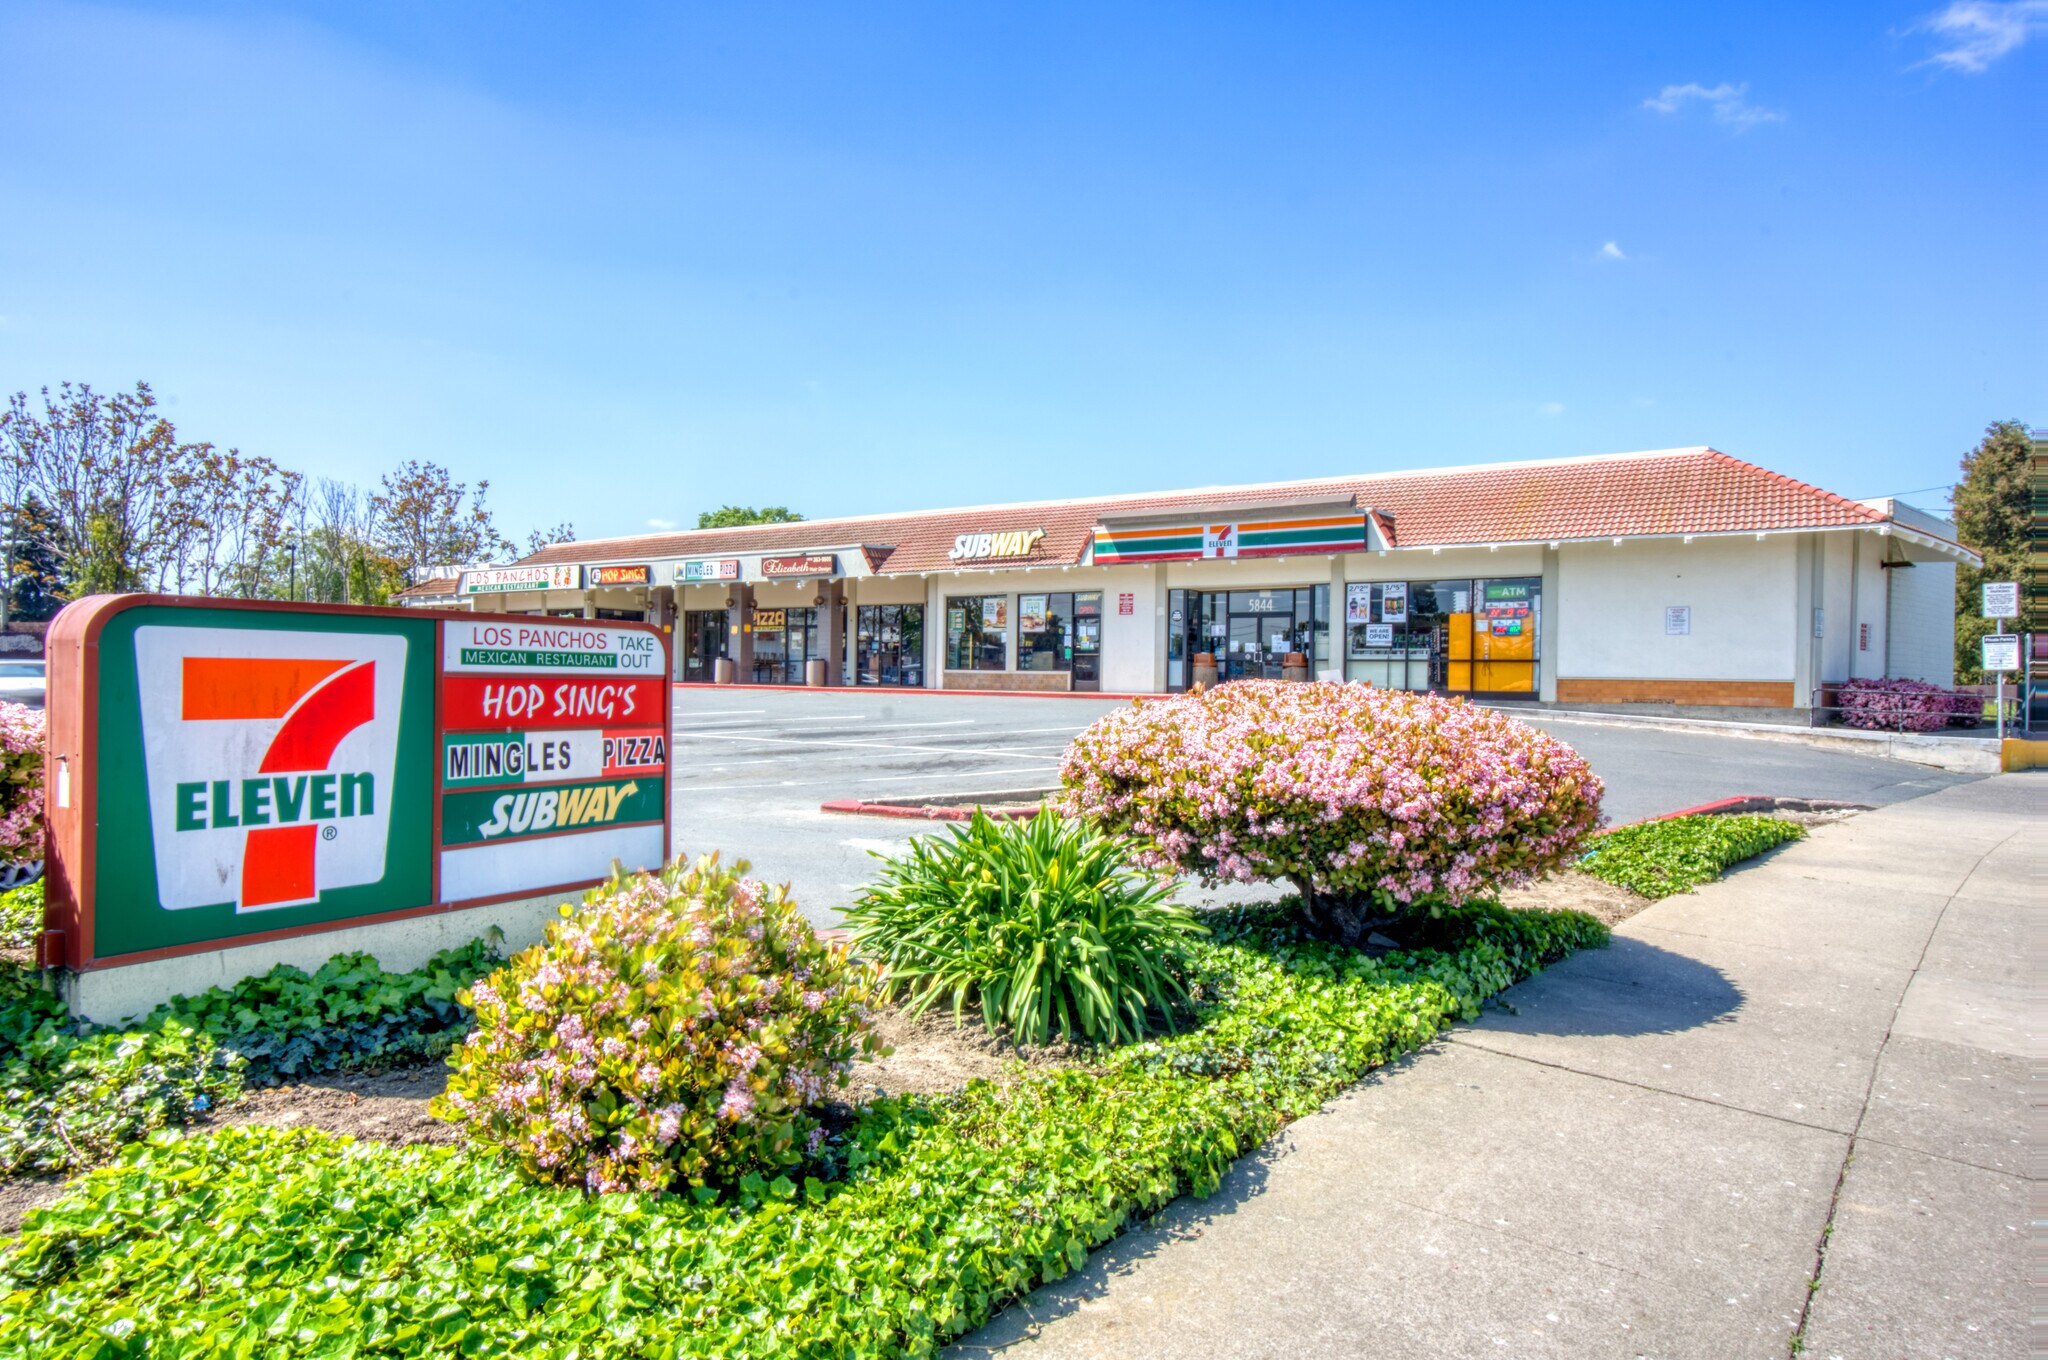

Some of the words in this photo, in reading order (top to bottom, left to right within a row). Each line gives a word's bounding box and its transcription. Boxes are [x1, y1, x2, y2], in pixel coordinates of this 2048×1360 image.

[948, 527, 1047, 560] SUBWAY
[601, 568, 620, 582] HOP
[620, 567, 646, 581] SING'S
[687, 565, 714, 576] MINGLES
[720, 564, 736, 575] PIZZA
[762, 559, 809, 574] Elizabeth
[469, 571, 490, 585] LOS
[495, 567, 549, 583] PANCHOS
[476, 584, 501, 592] MEXICAN
[502, 582, 540, 591] RESTAURANT
[1502, 587, 1526, 596] ATM
[1076, 593, 1101, 602] SUBWAY
[1248, 599, 1273, 612] 5844
[473, 626, 512, 647] LOS
[519, 628, 608, 650] PANCHOS
[618, 635, 655, 652] TAKE
[465, 650, 528, 665] MEXICAN
[536, 652, 615, 667] RESTAURANT
[620, 653, 652, 669] OUT
[482, 683, 545, 720] HOP
[553, 683, 637, 720] SING'S
[447, 739, 572, 780] MINGLES
[602, 735, 665, 768] PIZZA
[181, 656, 376, 908] 7
[478, 780, 640, 840] SUBWAY
